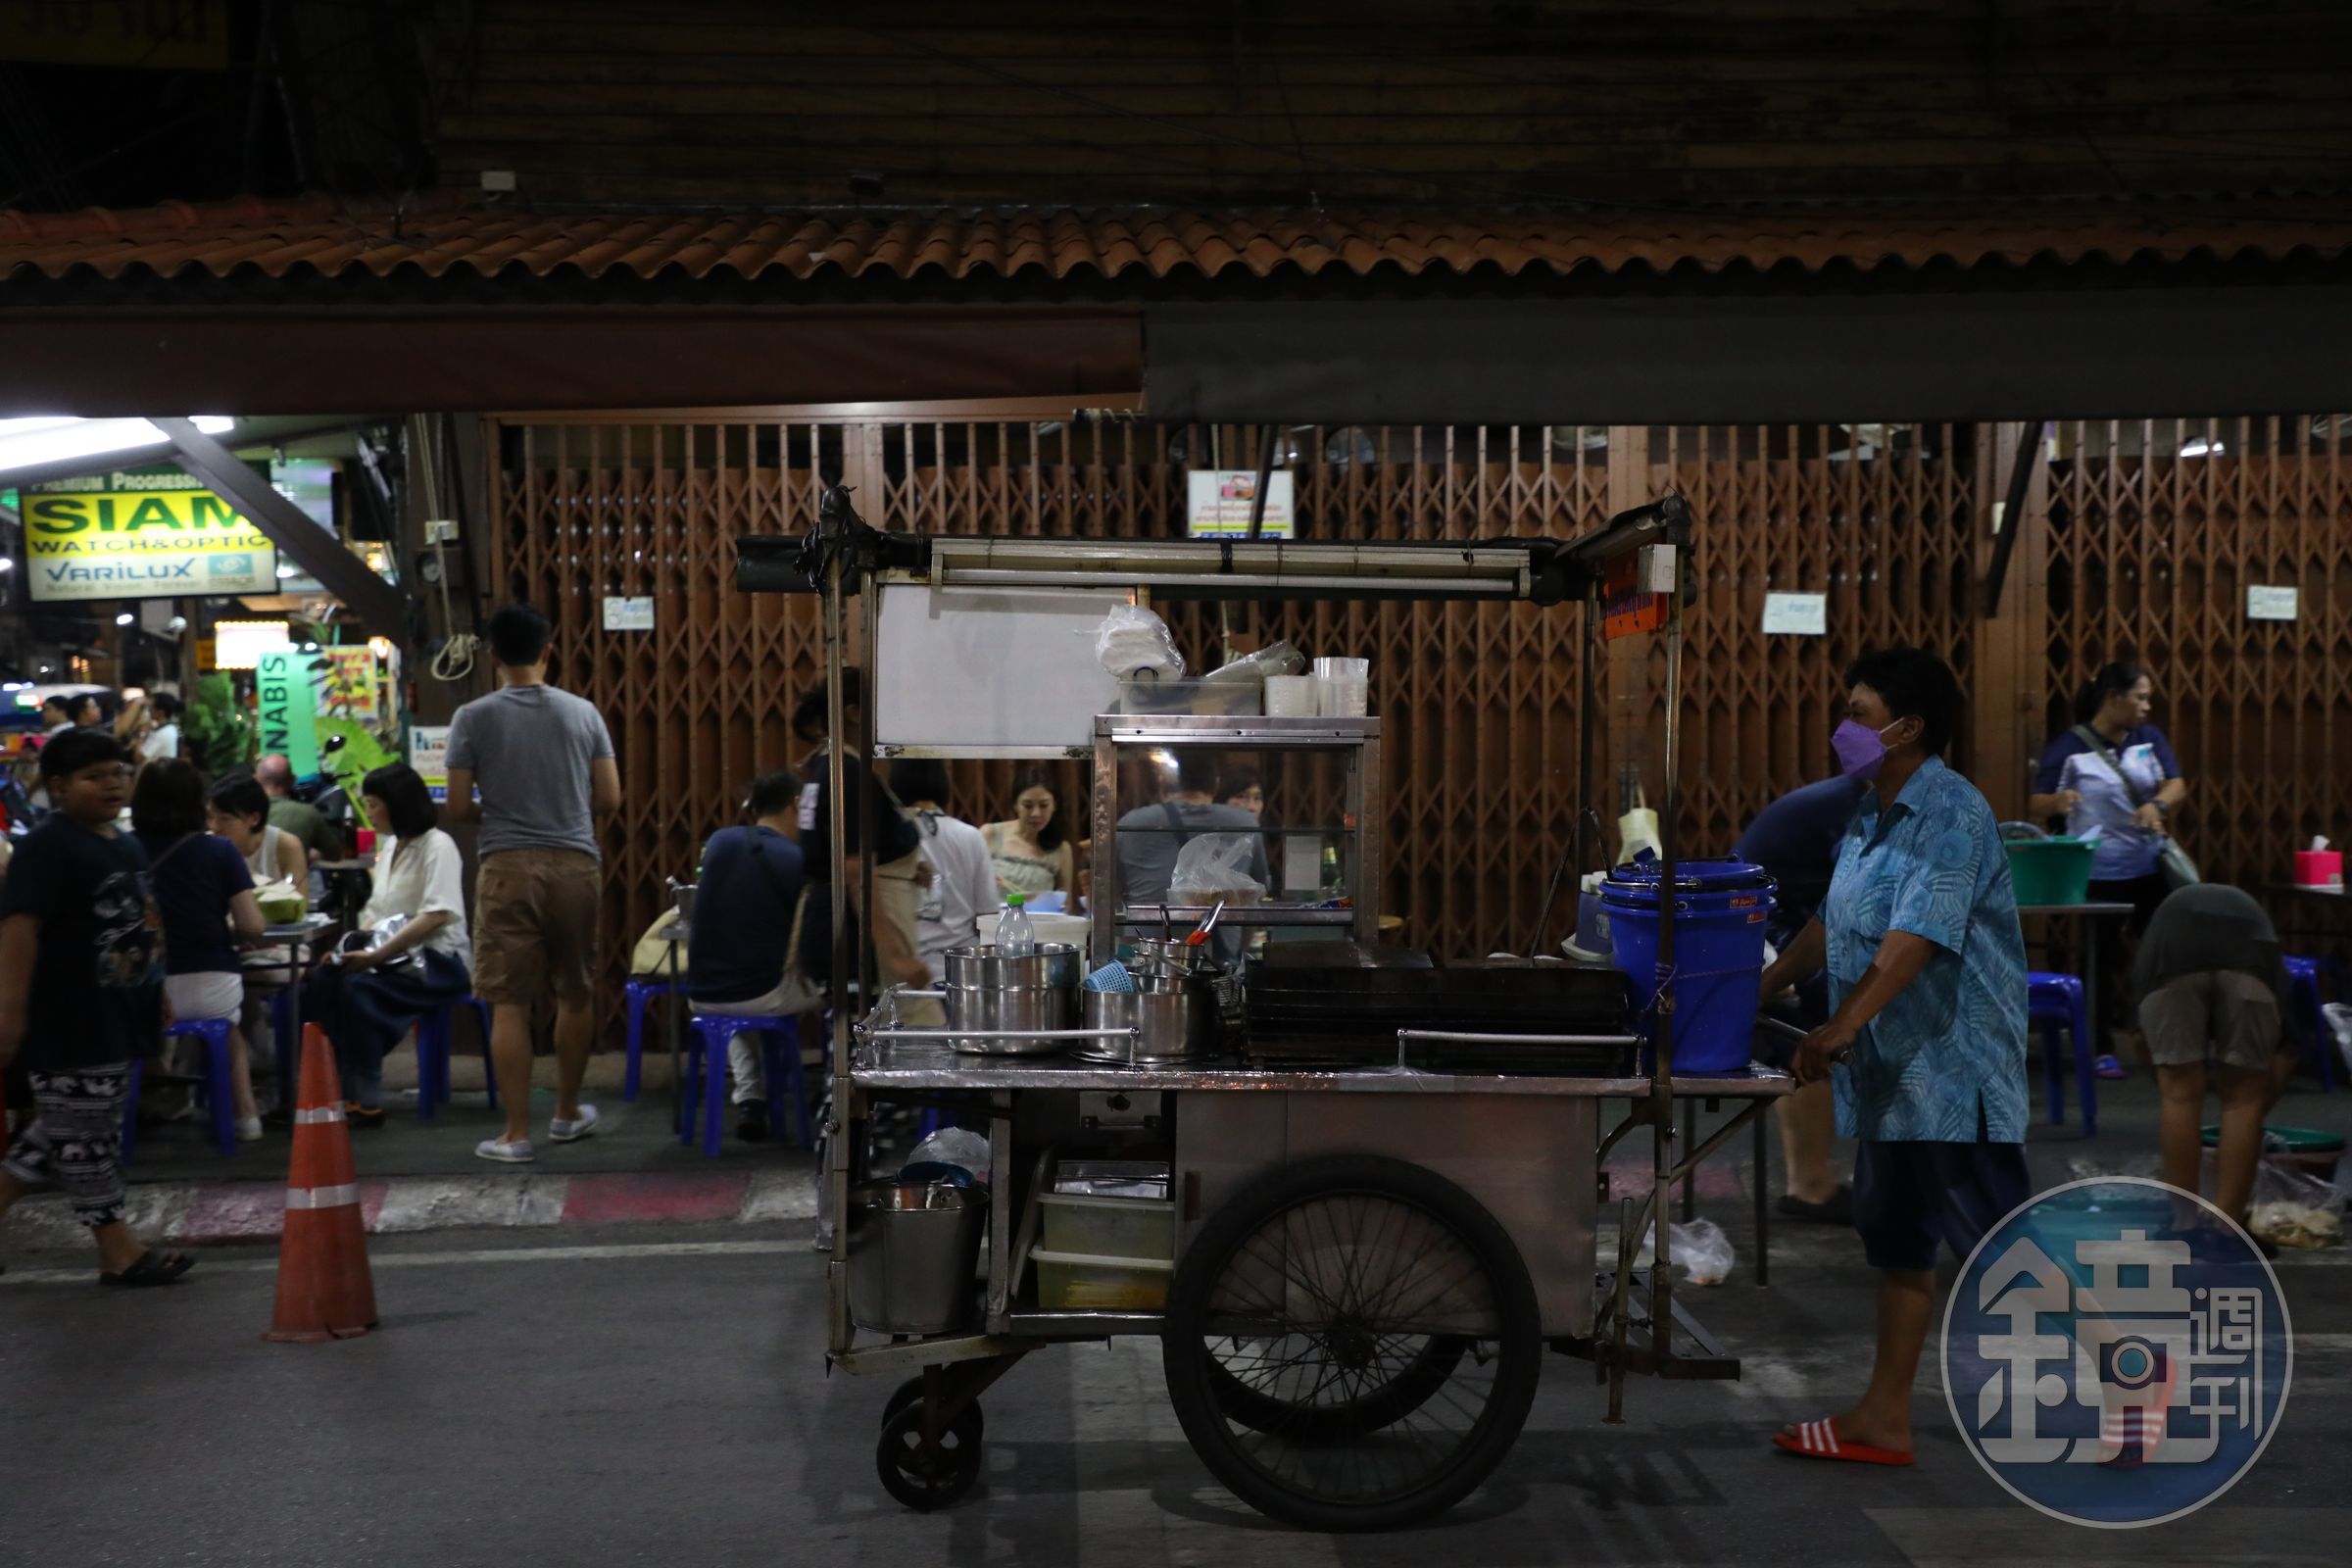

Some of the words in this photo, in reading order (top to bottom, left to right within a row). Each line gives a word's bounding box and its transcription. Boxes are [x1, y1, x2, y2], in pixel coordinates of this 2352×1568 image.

[111, 471, 204, 490] PROGRESSI
[32, 497, 242, 534] SIAM
[32, 535, 268, 554] WATCH&OPTIC
[263, 656, 288, 758] NABIS
